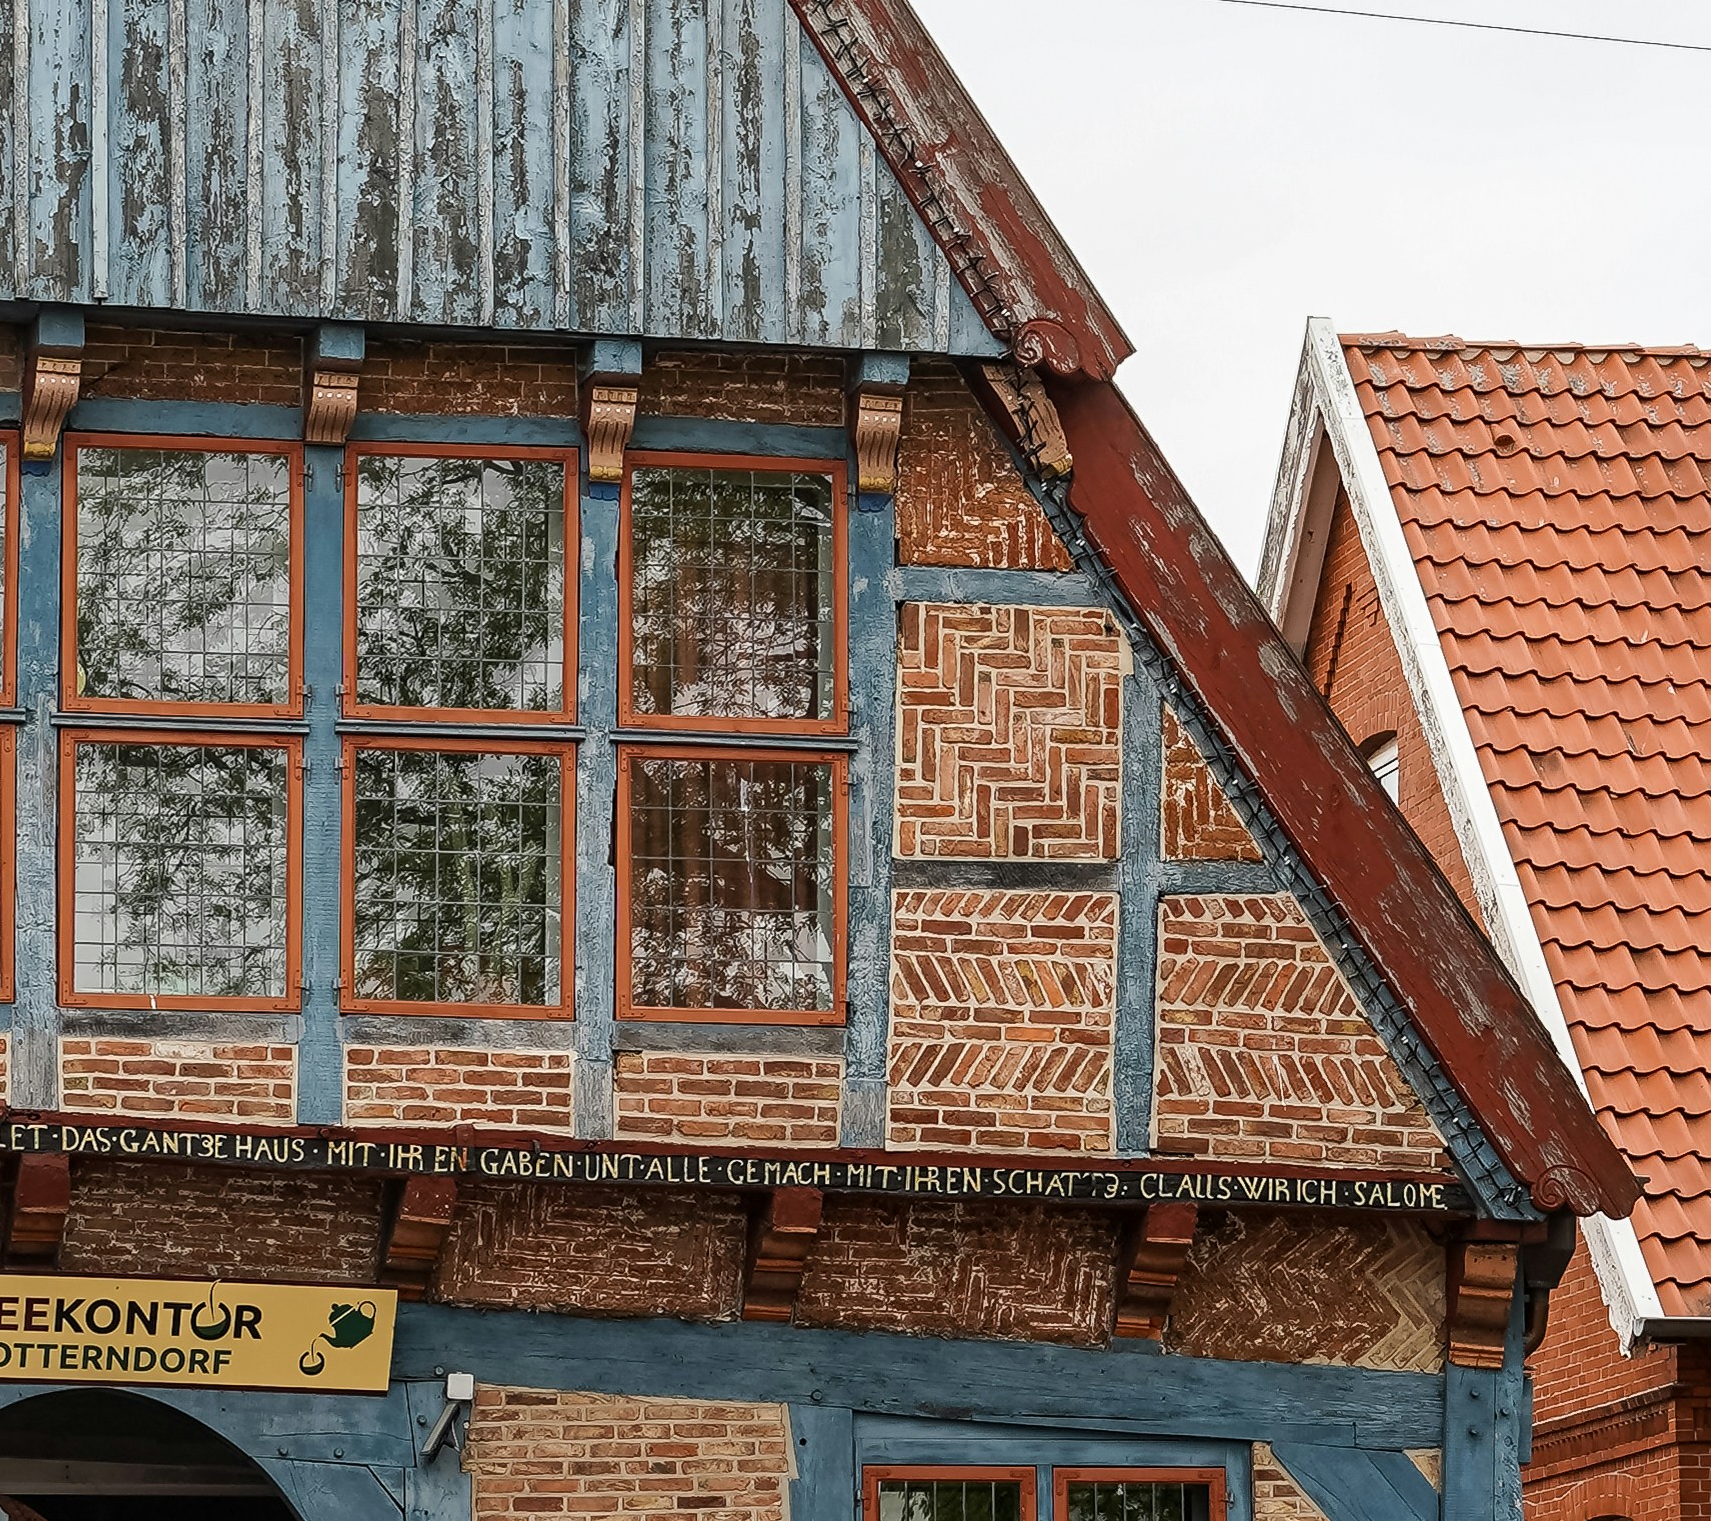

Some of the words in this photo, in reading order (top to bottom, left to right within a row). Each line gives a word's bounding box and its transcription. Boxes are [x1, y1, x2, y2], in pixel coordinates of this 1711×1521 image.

[61, 1126, 110, 1152] DAS
[235, 1135, 305, 1163] HAUS
[327, 1141, 376, 1167] MIT
[480, 1148, 574, 1178] GABEN
[644, 1156, 711, 1183] ALLE
[847, 1164, 898, 1189] MIT
[1237, 1175, 1336, 1205] WIRICH
